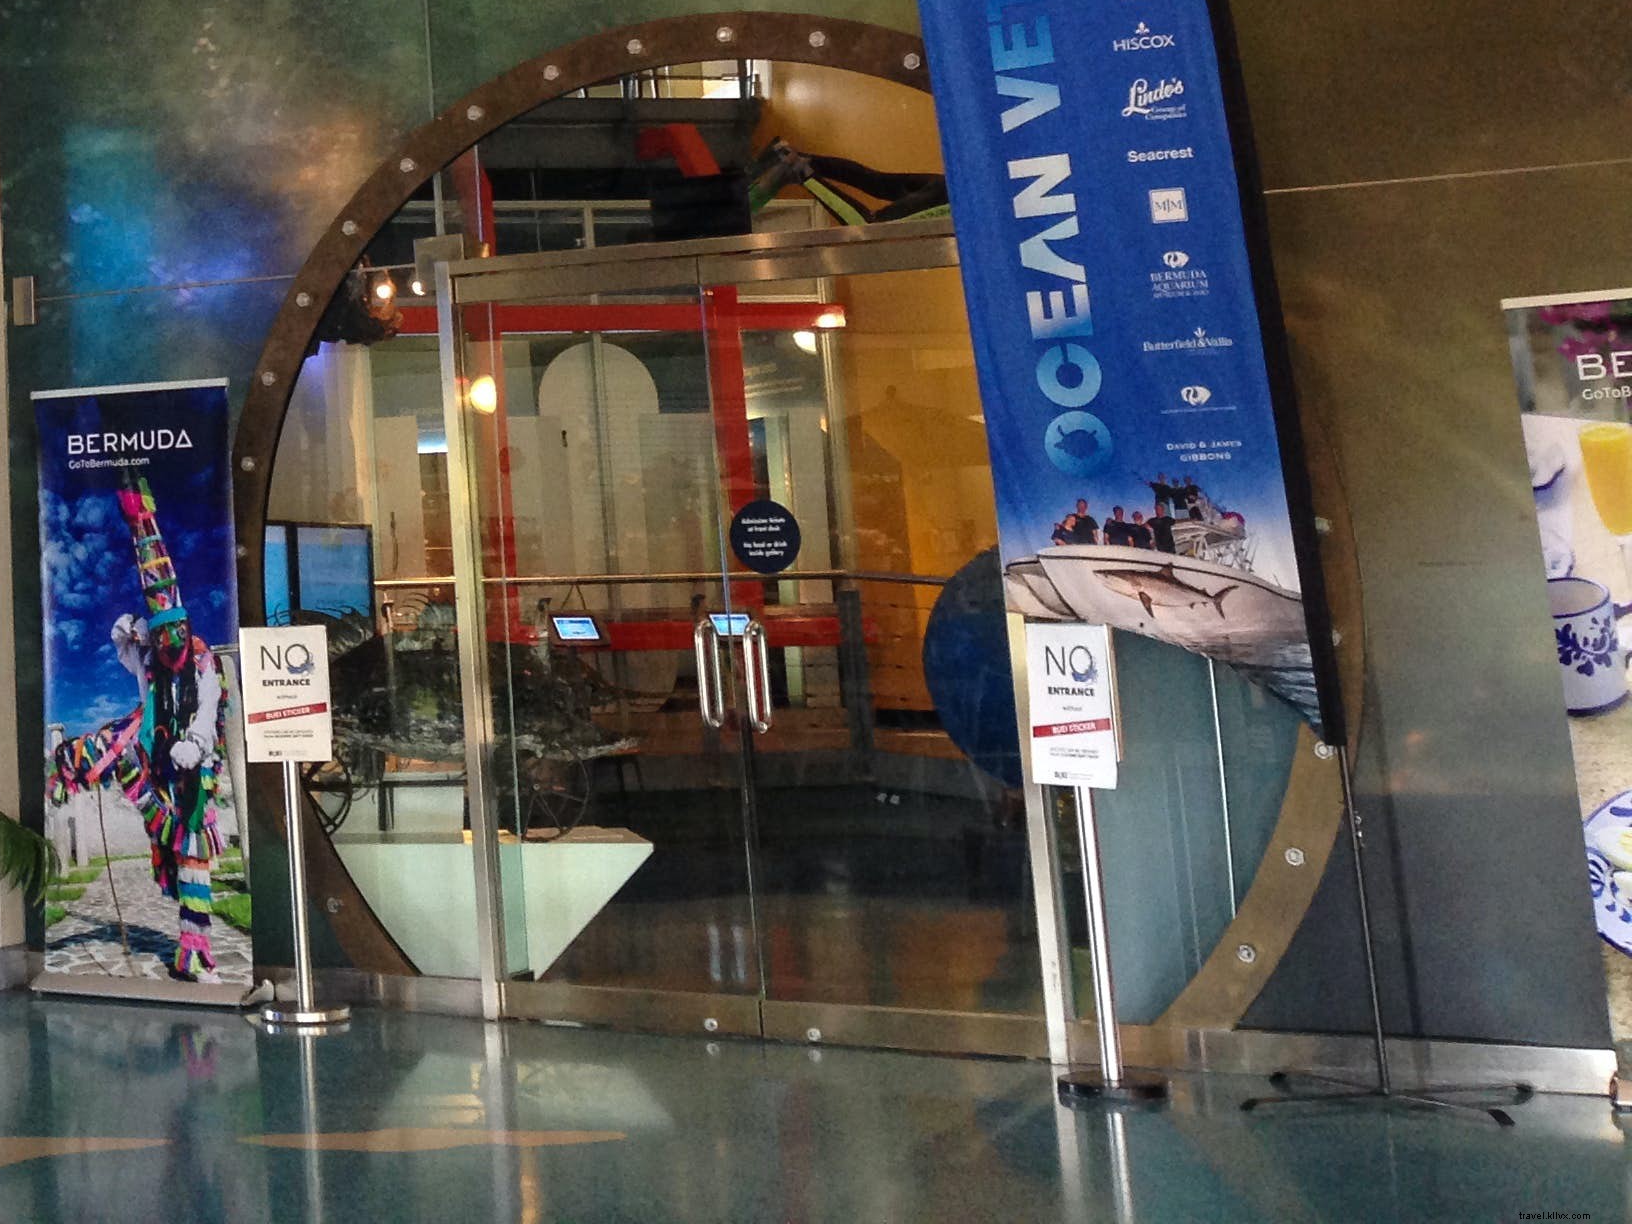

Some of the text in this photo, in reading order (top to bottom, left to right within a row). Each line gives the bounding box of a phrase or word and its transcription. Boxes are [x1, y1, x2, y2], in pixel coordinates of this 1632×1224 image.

[1112, 35, 1176, 52] HISCOX
[1121, 78, 1185, 117] Lindo's
[1127, 146, 1194, 163] Seacrest
[67, 428, 193, 455] BERMUDA
[68, 457, 150, 470] GoToBermuda.com
[1180, 452, 1232, 463] GIBBONS
[260, 643, 311, 672] NO
[1045, 645, 1094, 678] NO
[262, 678, 311, 688] ENTRANCE
[1048, 686, 1096, 698] ENTRANCE
